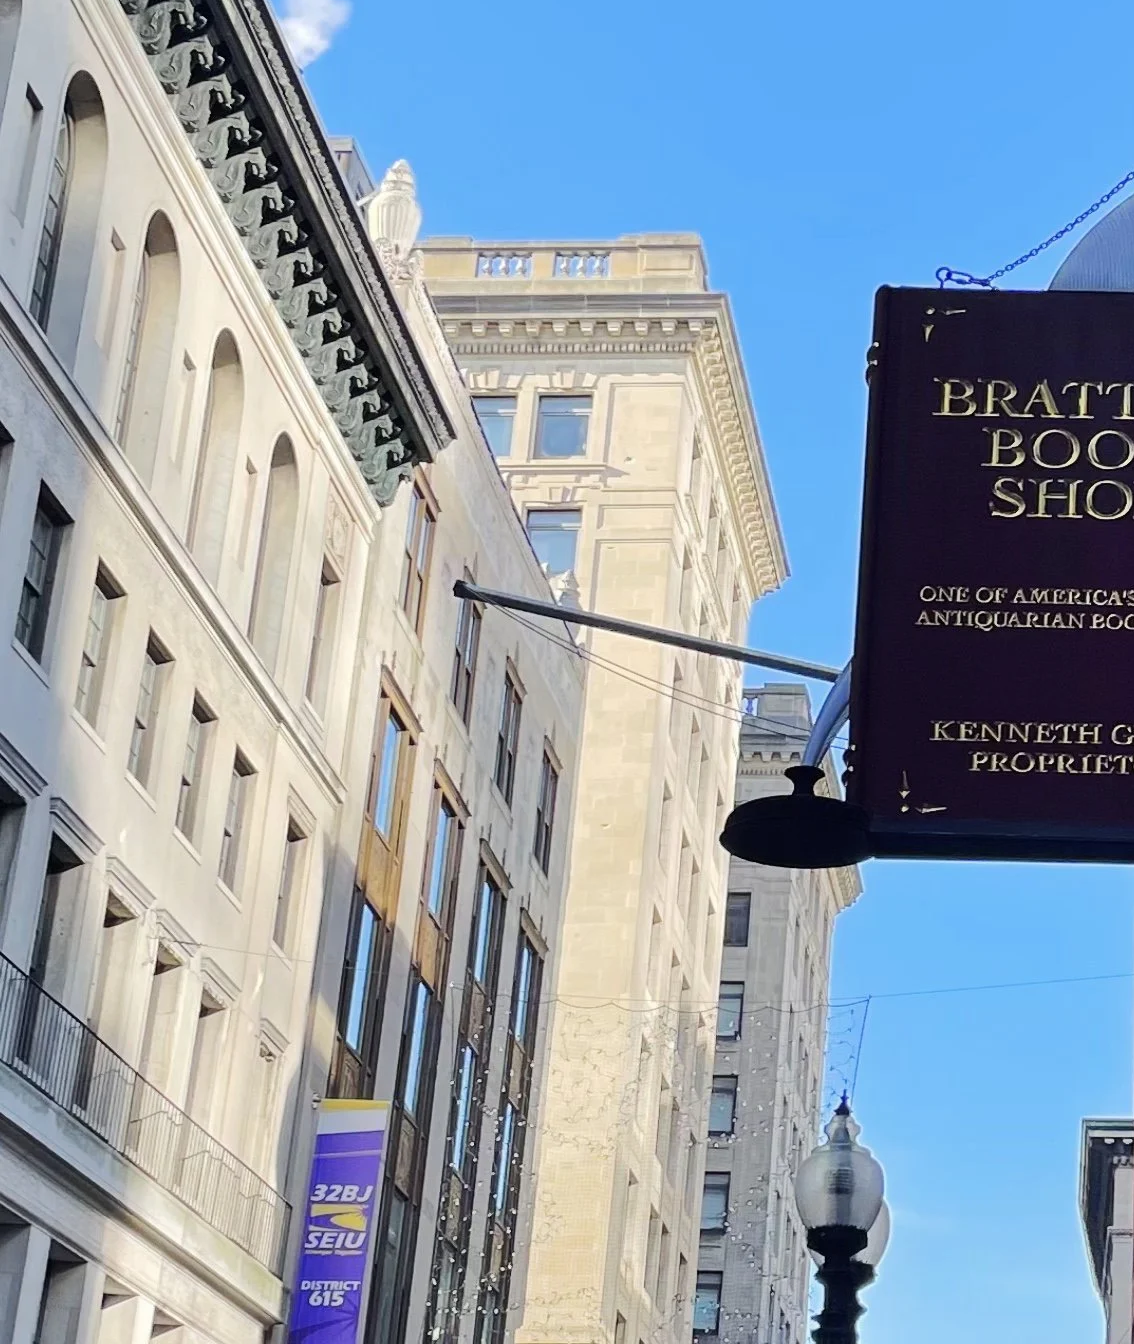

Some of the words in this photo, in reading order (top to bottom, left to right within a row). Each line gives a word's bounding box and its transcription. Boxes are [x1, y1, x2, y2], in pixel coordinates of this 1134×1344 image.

[919, 586, 970, 604] ONE
[975, 587, 1007, 605] OF
[915, 610, 1086, 631] ANTIQUARIAN
[929, 720, 1103, 744] KENNETH
[310, 1184, 374, 1202] 32BJ
[304, 1232, 367, 1249] SEIU
[300, 1280, 361, 1291] DISTRICT
[308, 1290, 345, 1307] 615
